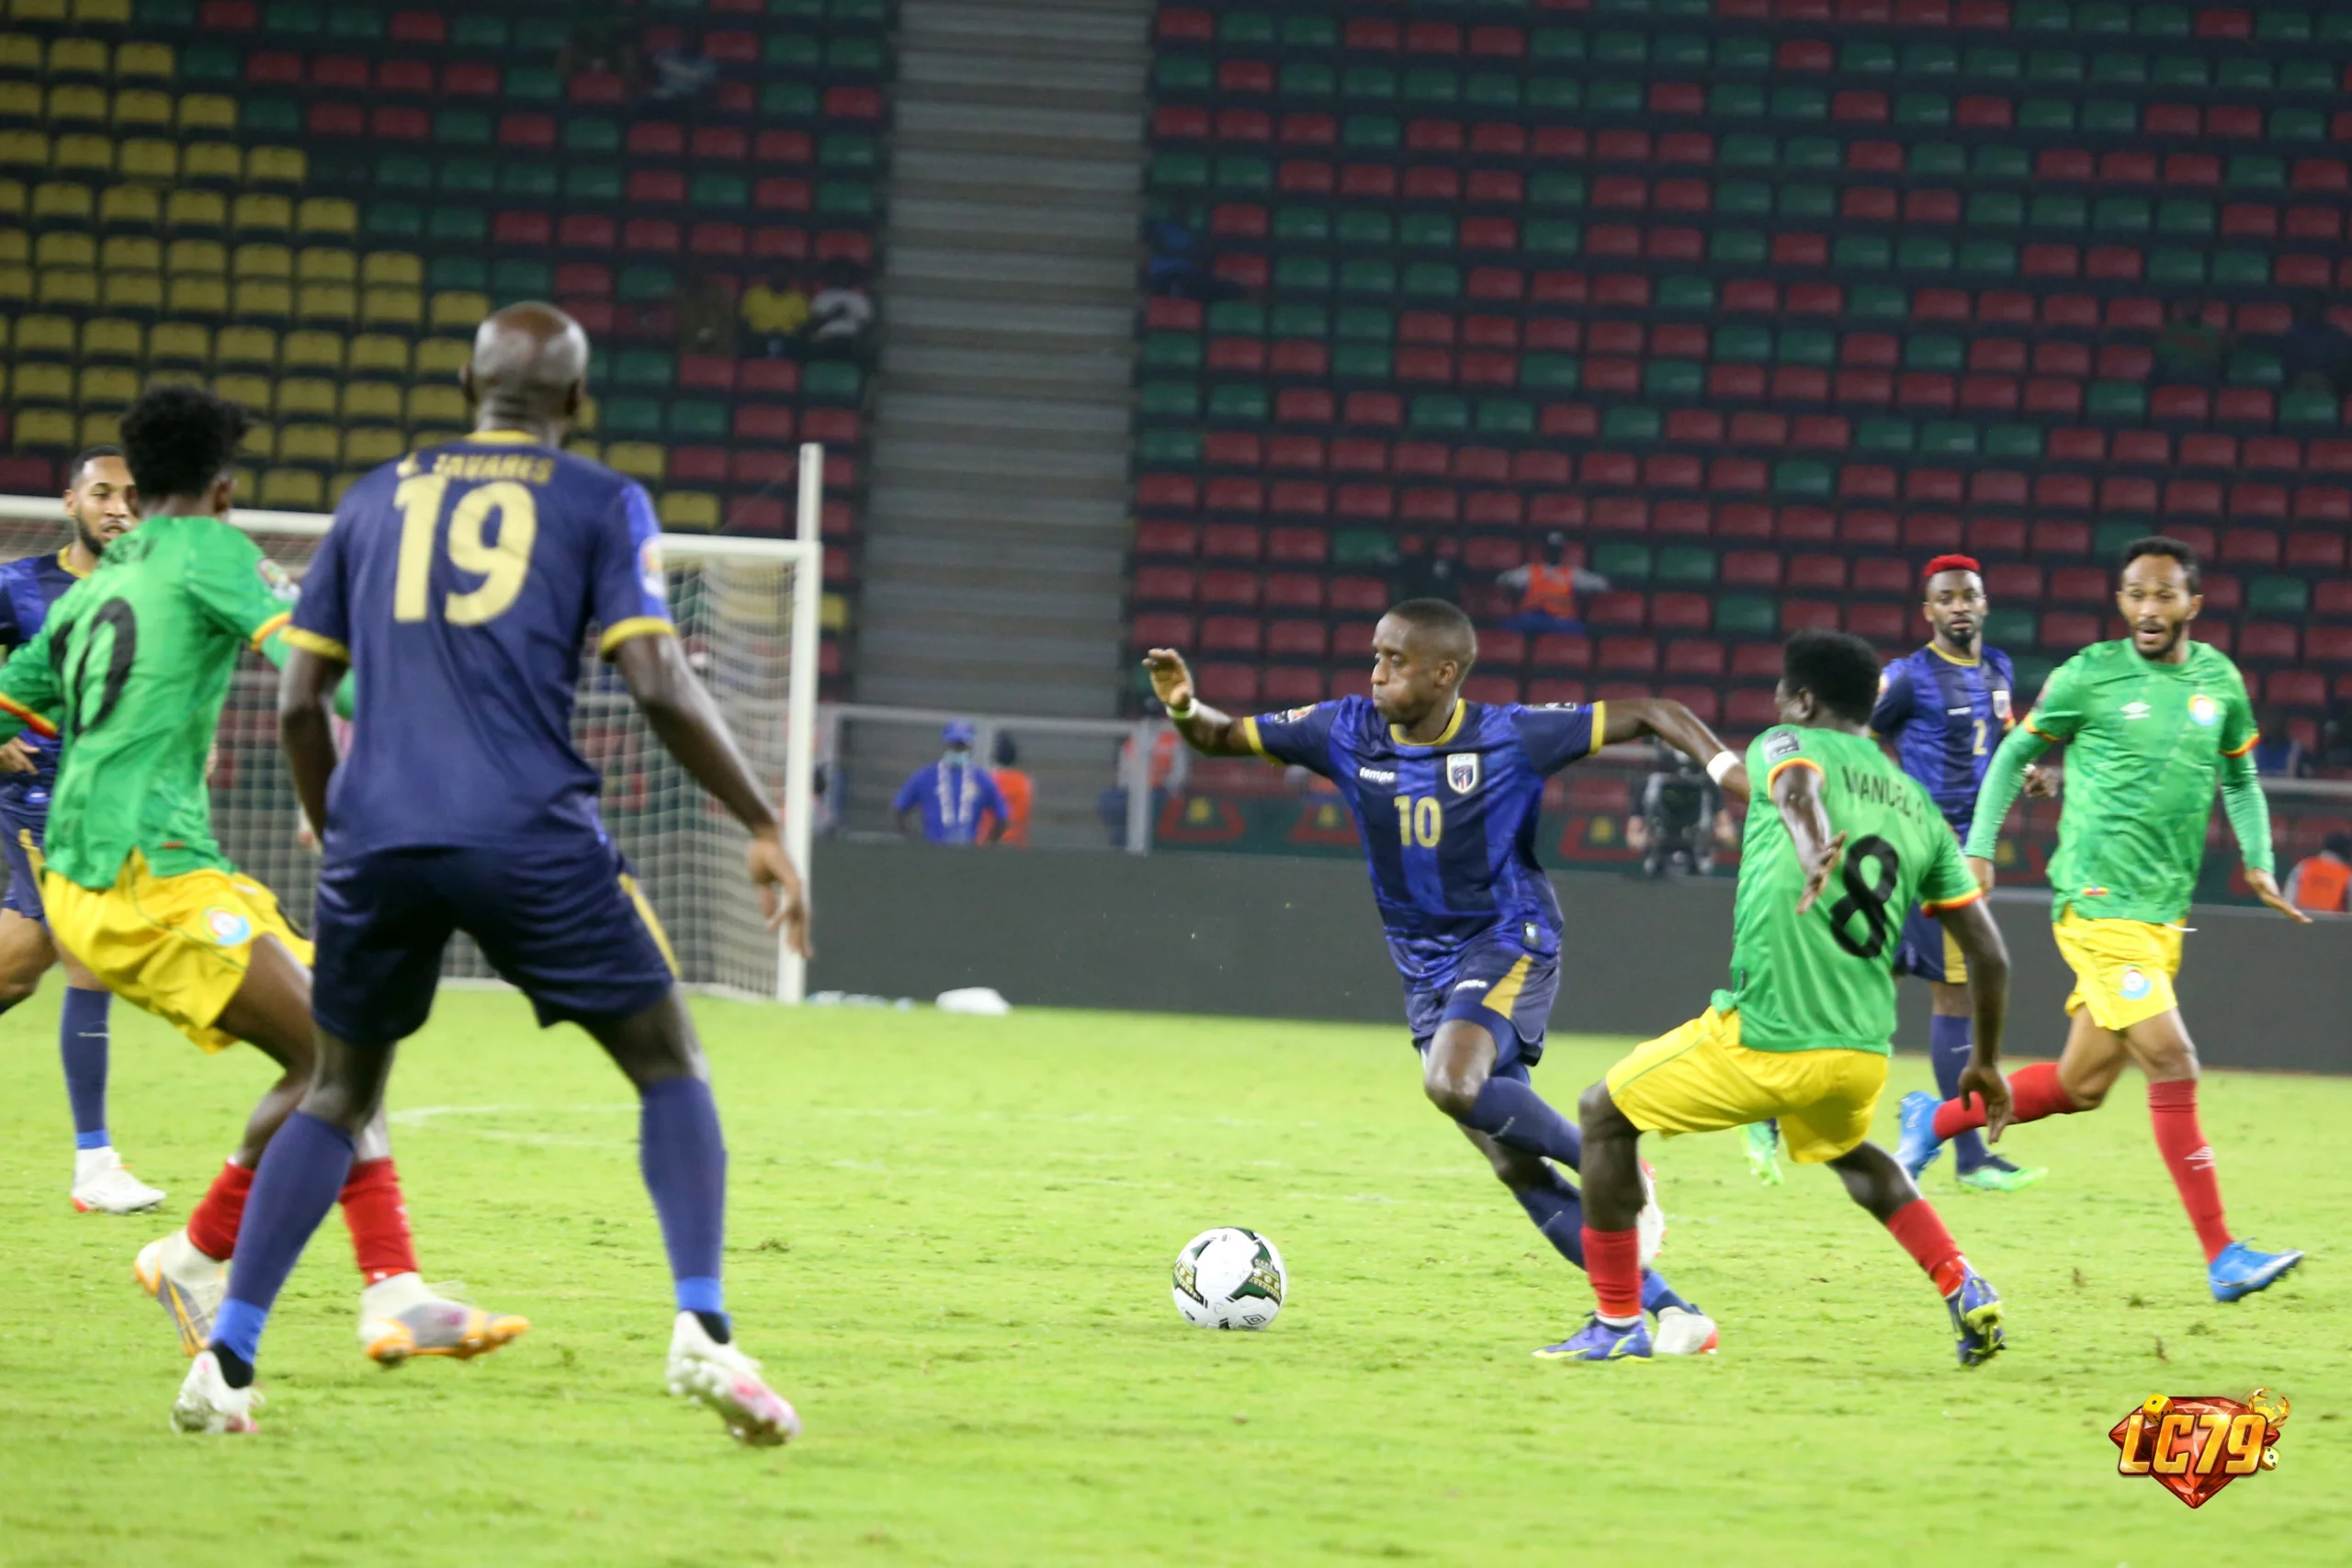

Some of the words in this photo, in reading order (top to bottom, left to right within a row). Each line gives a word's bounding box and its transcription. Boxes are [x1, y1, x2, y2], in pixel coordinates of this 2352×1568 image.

[393, 473, 537, 626] 19
[1973, 719, 1988, 755] 2
[1360, 766, 1396, 784] tempo
[1394, 795, 1442, 848] 10
[1830, 835, 1899, 959] 8
